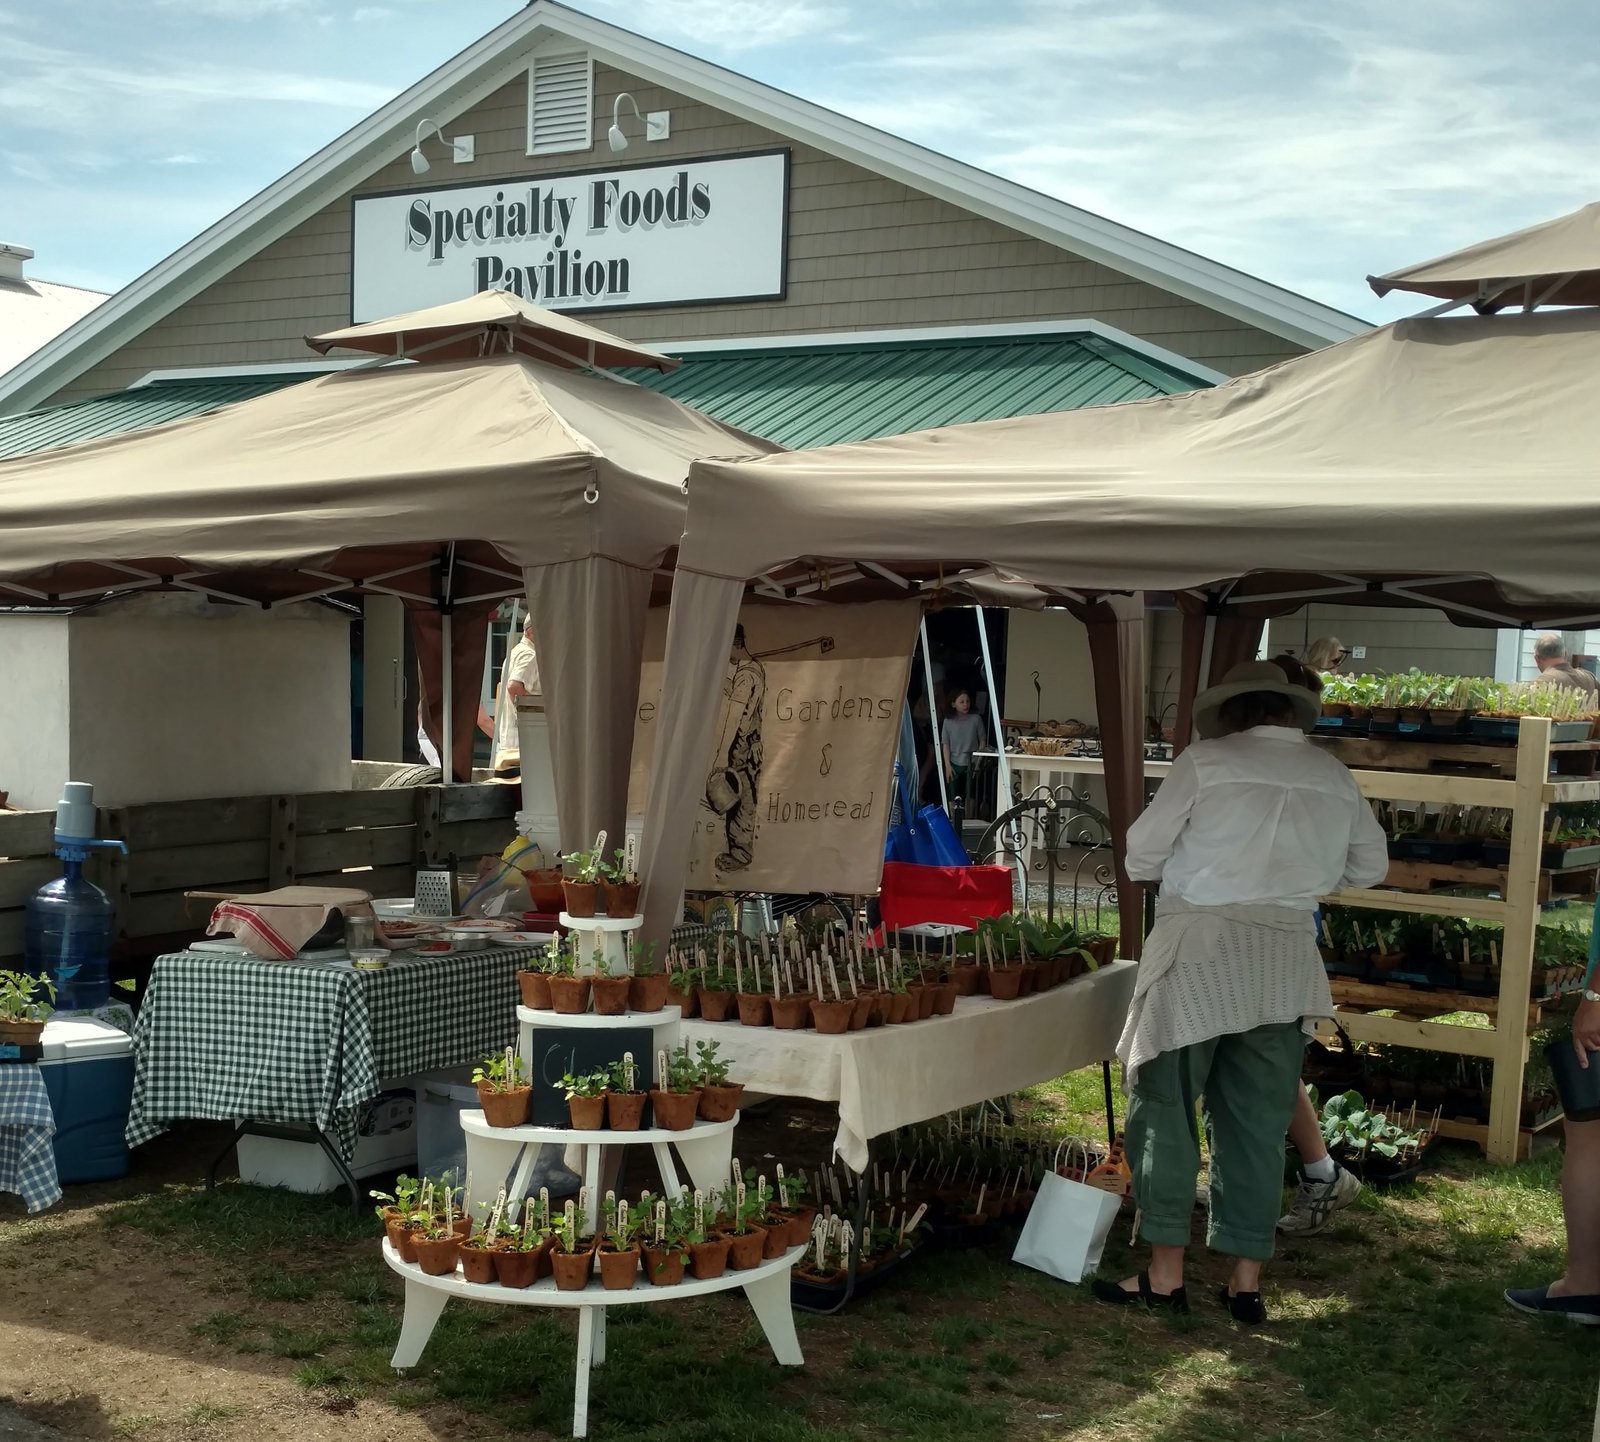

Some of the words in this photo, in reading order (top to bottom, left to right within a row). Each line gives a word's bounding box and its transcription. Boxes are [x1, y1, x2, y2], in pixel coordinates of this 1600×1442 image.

[408, 186, 577, 260] Specialty
[590, 172, 711, 231] Foods
[475, 249, 631, 300] Pavilion
[776, 686, 894, 722] Gardens
